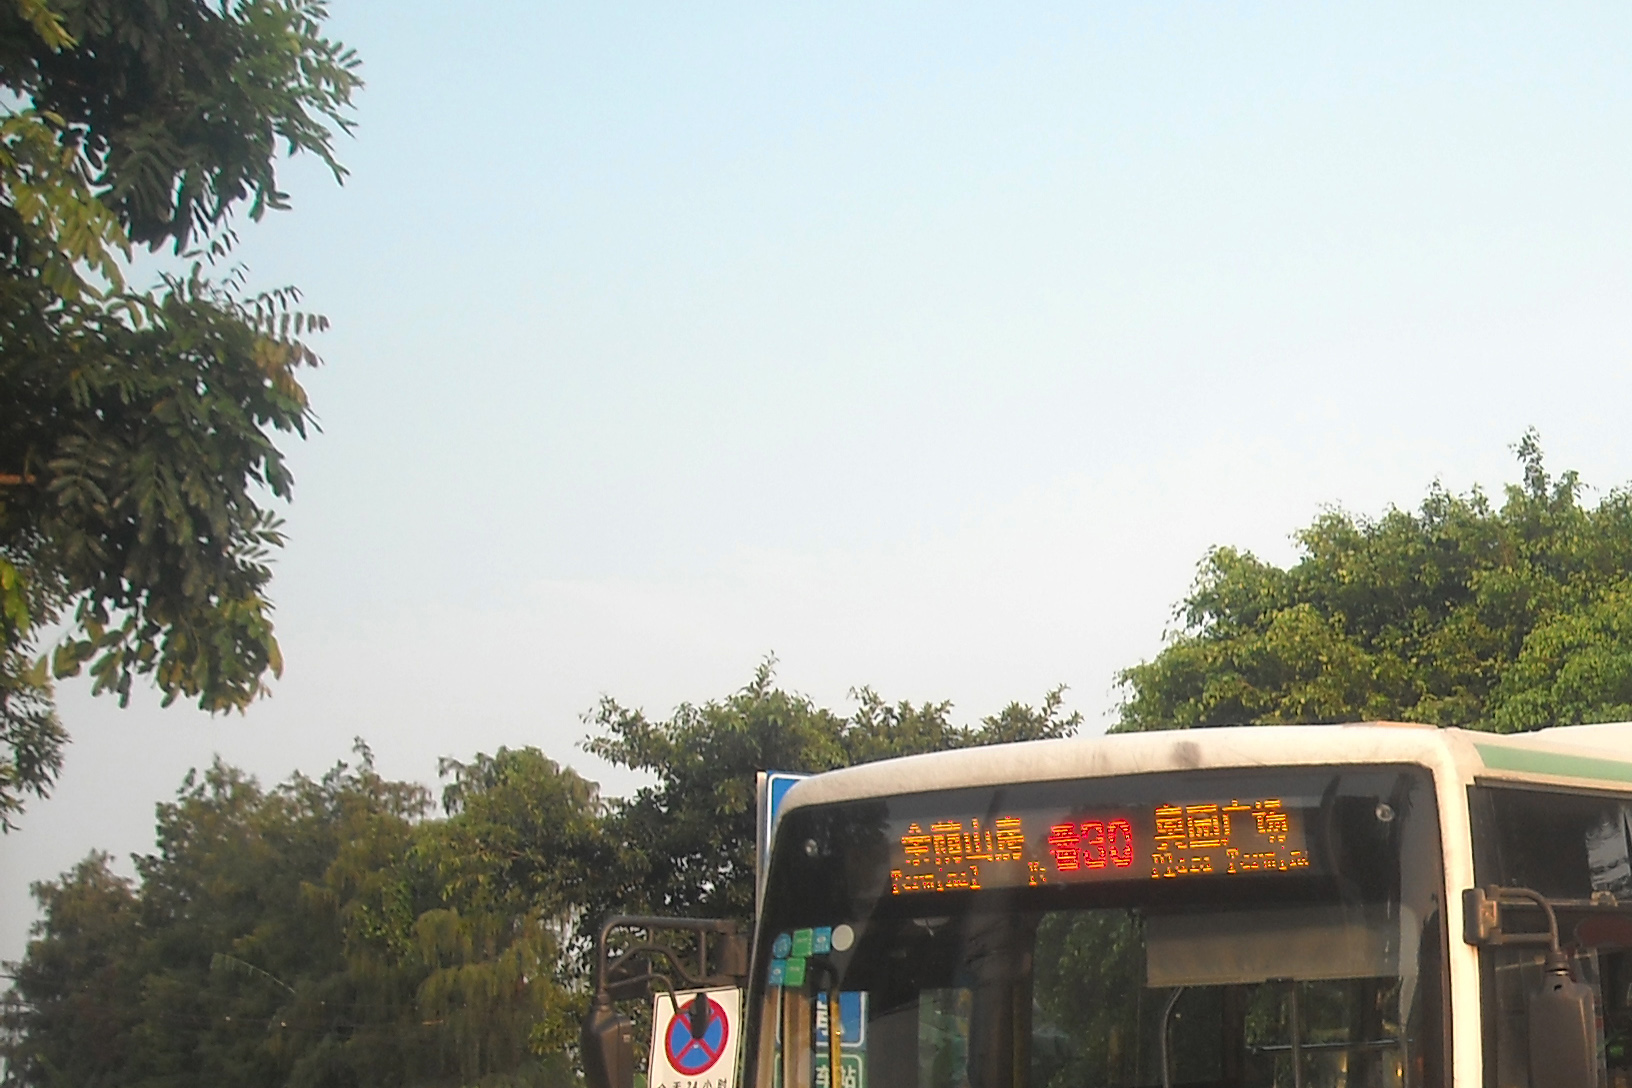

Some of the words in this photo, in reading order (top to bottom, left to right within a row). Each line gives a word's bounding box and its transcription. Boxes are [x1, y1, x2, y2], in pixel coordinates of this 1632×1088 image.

[1047, 818, 1133, 872] 番30
[1154, 799, 1289, 850] 奥园广场
